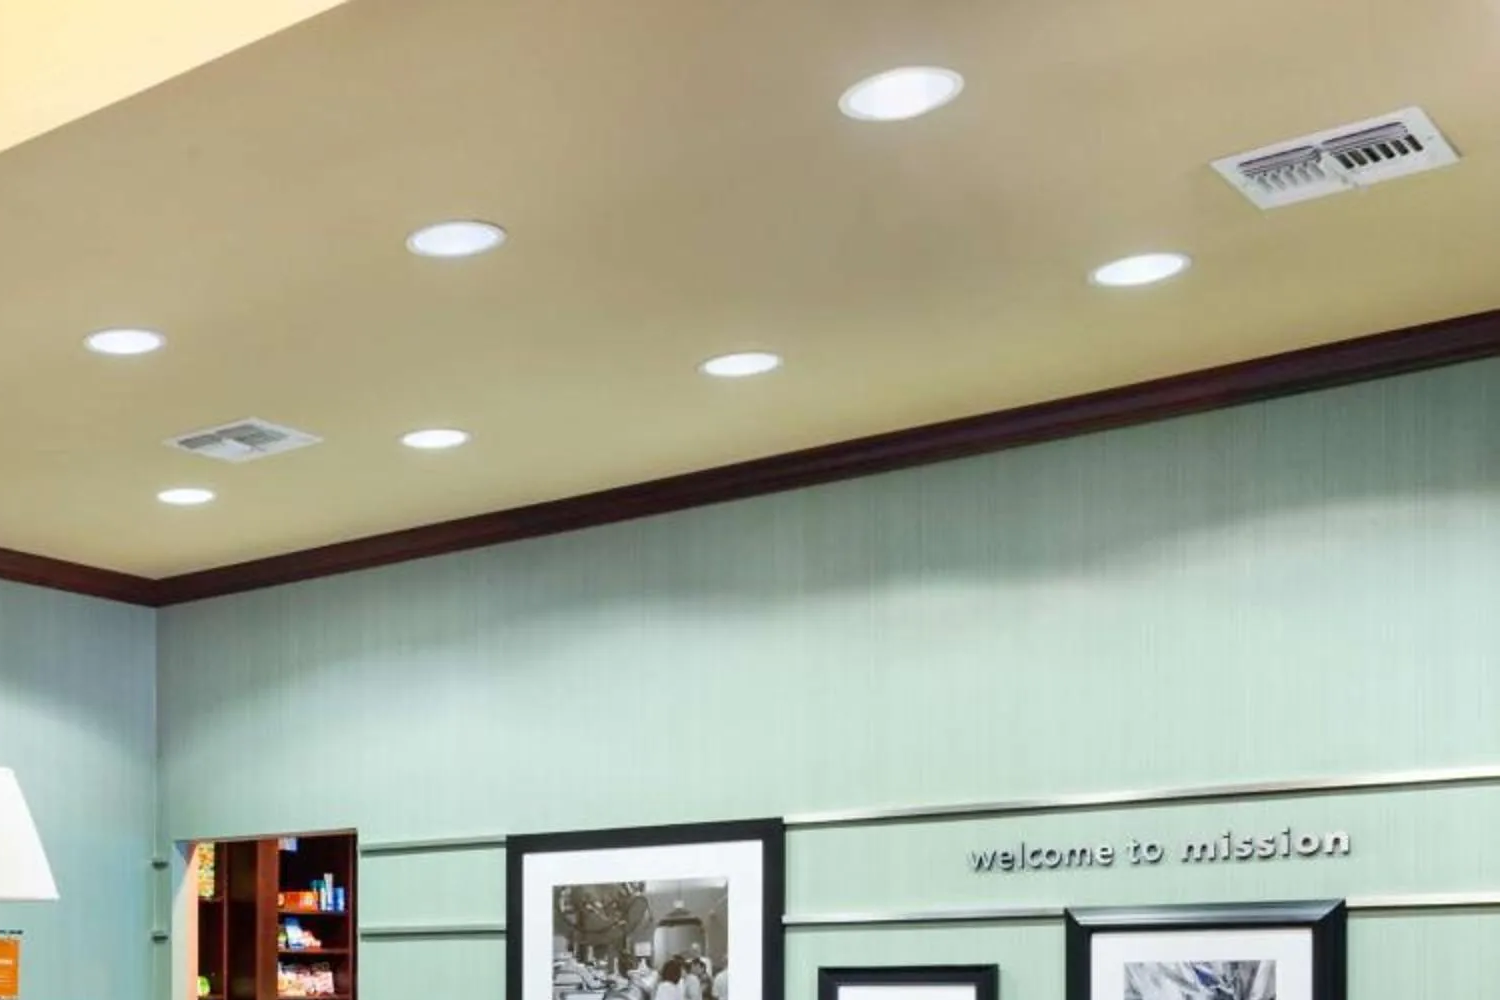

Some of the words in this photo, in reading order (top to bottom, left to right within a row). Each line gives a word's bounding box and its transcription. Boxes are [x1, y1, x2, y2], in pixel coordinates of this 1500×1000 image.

[969, 840, 1114, 873] welcome
[1126, 837, 1165, 865] to
[1181, 826, 1352, 863] mission
